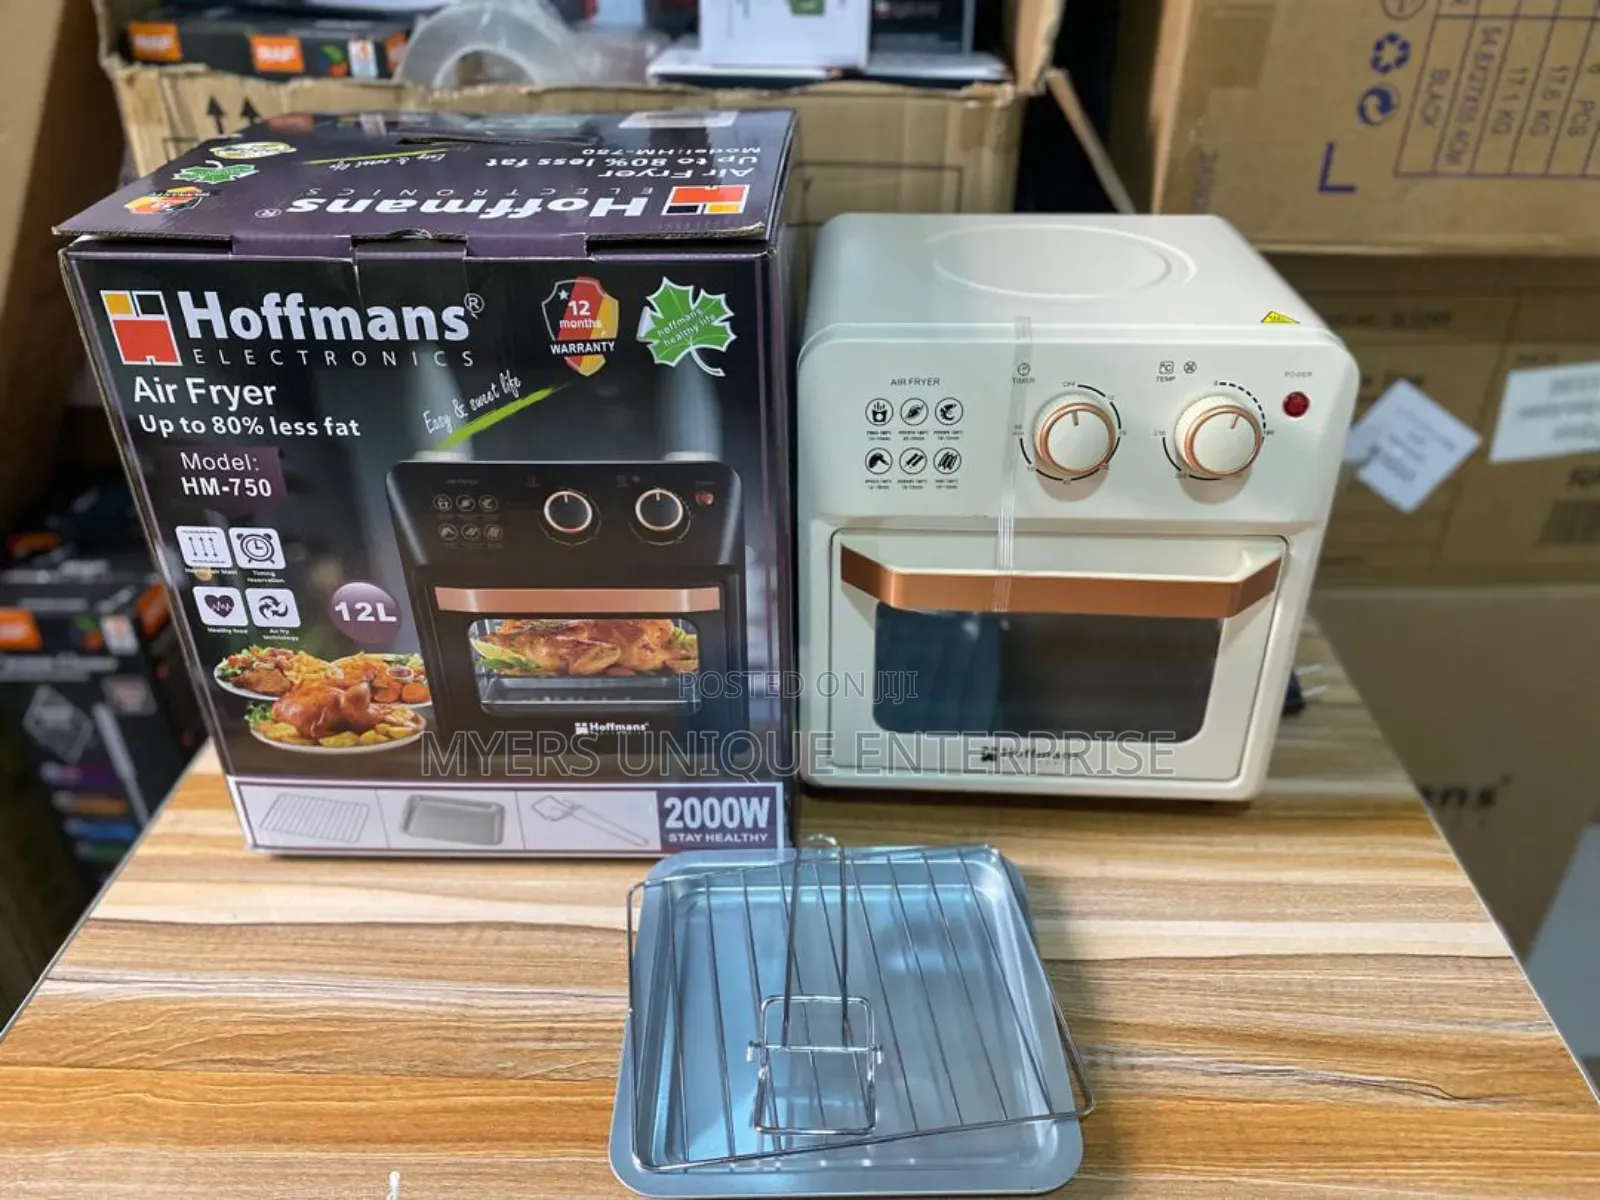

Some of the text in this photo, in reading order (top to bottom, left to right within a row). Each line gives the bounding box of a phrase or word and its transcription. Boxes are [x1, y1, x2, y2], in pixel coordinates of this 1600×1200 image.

[485, 155, 758, 168] Up to 80% less fat
[1317, 142, 1357, 193] L
[598, 167, 755, 179] Air Fryer
[306, 187, 653, 197] ELECTRONICS
[567, 300, 591, 315] 12
[559, 317, 603, 331] months
[664, 312, 717, 347] healthy life
[550, 340, 616, 356] WARRANTY
[192, 348, 474, 368] ELECTRONICS
[889, 377, 941, 387] AIR FRYER
[1156, 375, 1176, 383] TEMP
[1284, 371, 1313, 379] POWER
[133, 376, 277, 413] Air Fryer
[422, 369, 523, 435] Easy & sweet life
[138, 413, 361, 438] Up to 80% less fat
[180, 451, 260, 473] Model:
[181, 475, 272, 498] HM-750
[335, 601, 398, 623] 12L
[663, 796, 771, 831] 2000W
[668, 831, 768, 843] STAY HEALTHY
